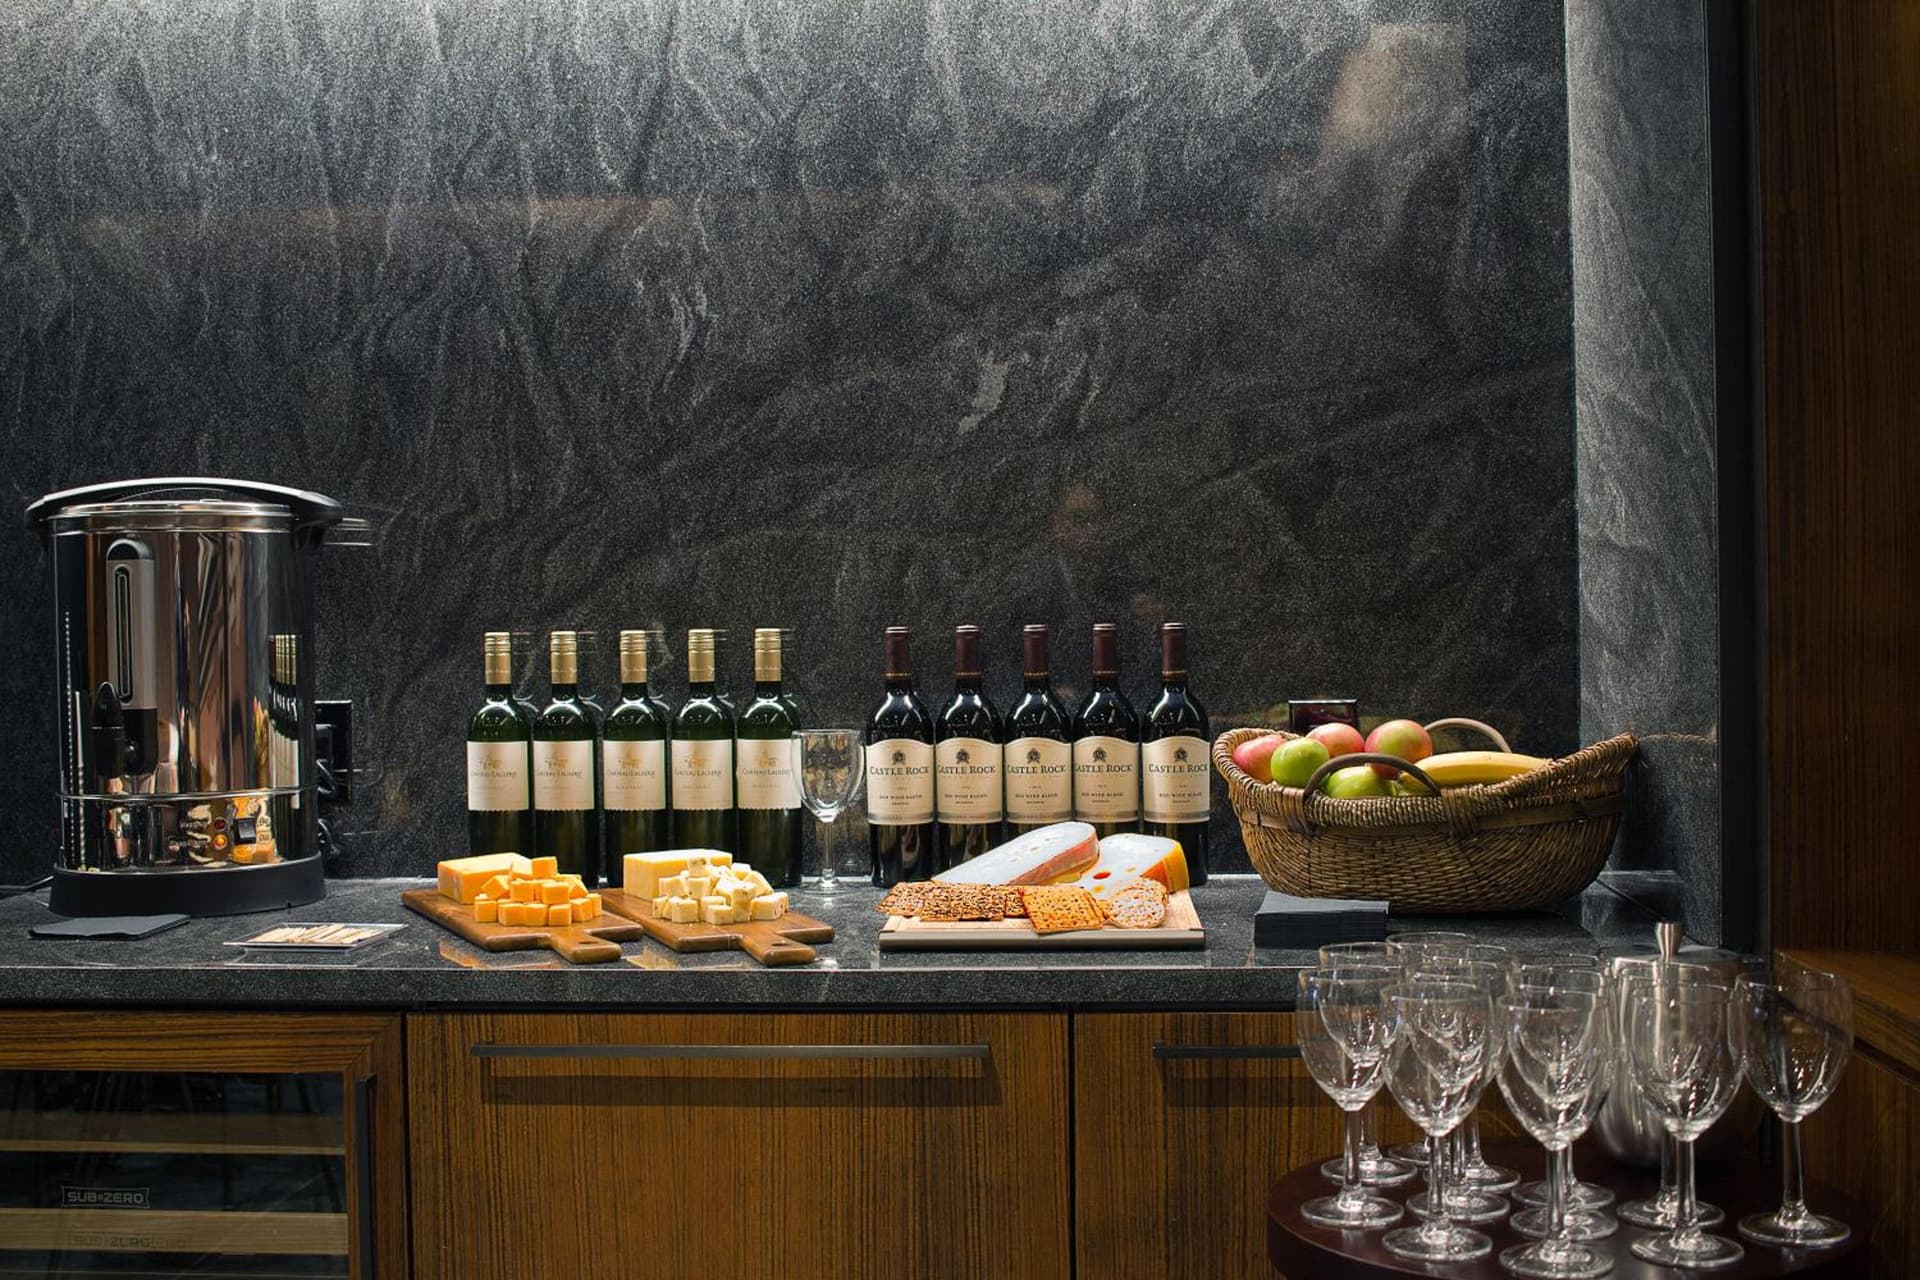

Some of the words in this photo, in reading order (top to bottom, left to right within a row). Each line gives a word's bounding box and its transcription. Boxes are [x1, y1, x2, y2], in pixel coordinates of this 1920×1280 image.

[870, 766, 903, 775] CASTLE
[906, 766, 929, 774] ROCK
[969, 765, 996, 773] ROCK
[1007, 765, 1038, 774] CASTLE
[1040, 765, 1066, 773] ROCK
[1106, 764, 1132, 773] ROCK
[1148, 764, 1183, 773] CASTLE
[1187, 764, 1208, 773] ROCK
